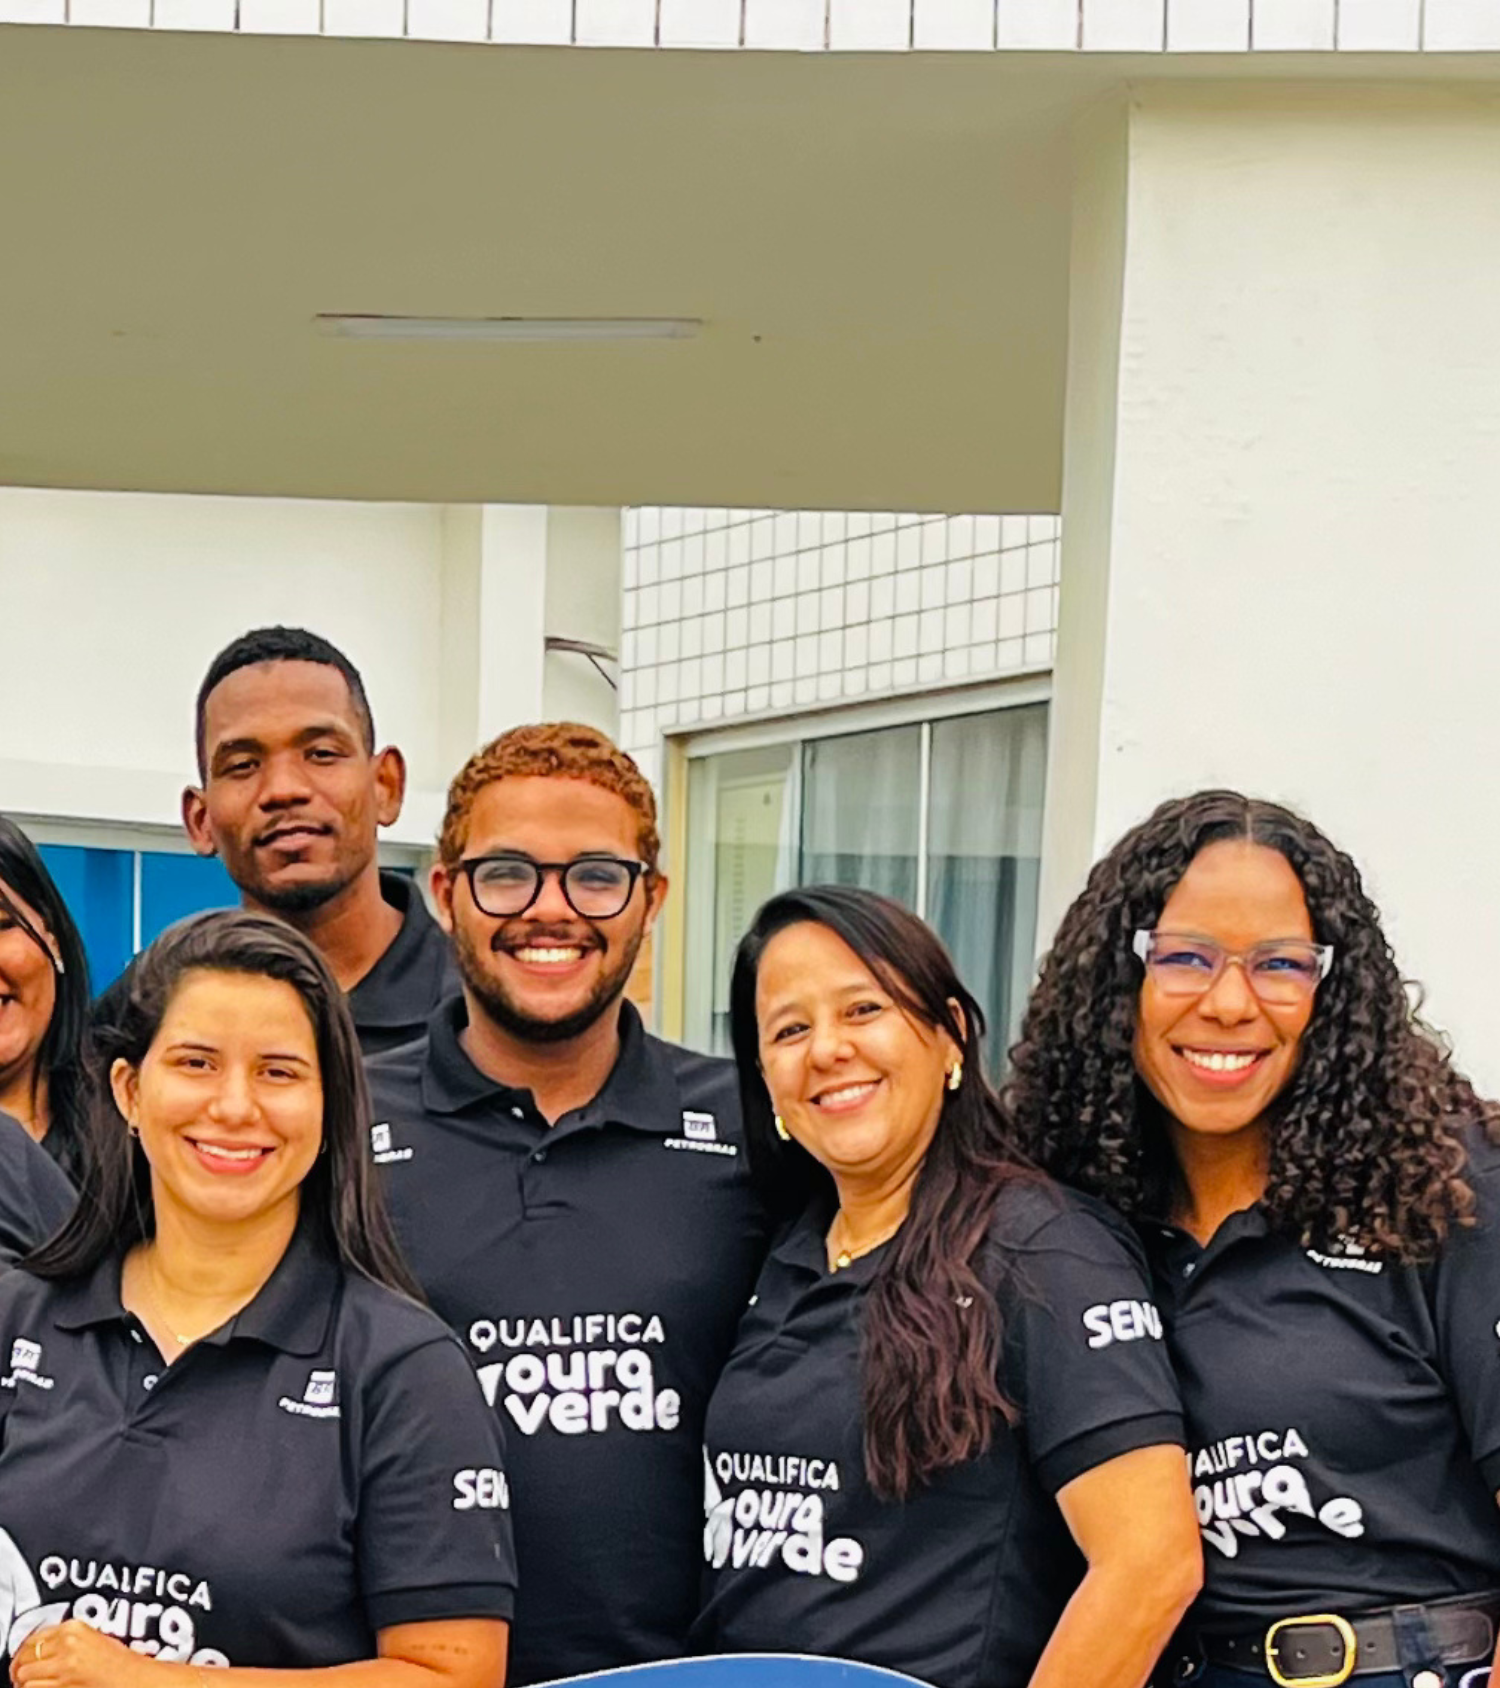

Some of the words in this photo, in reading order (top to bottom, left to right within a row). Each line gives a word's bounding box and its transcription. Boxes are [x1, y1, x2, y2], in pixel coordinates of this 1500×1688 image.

[467, 1311, 666, 1353] QUALIFICA
[1083, 1300, 1163, 1348] SEN
[503, 1388, 683, 1436] verde
[453, 1468, 509, 1509] SEN
[714, 1451, 841, 1492] QUALIFICA
